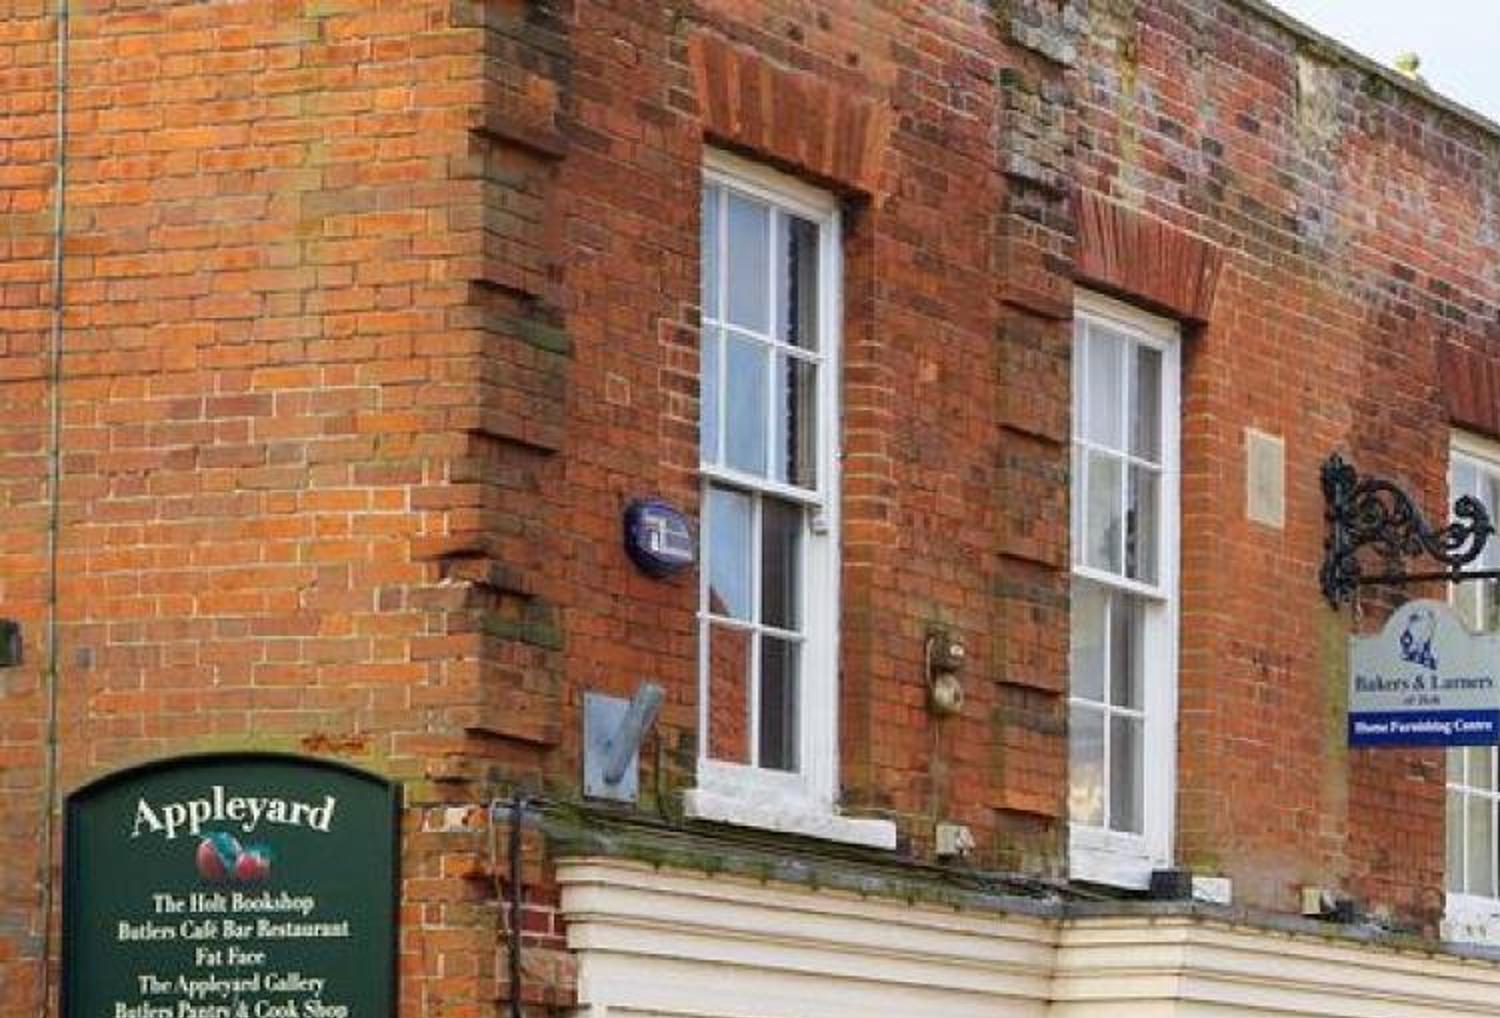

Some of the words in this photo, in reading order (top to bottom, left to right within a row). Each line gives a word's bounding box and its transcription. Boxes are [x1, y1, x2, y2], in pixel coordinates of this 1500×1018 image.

[1412, 674, 1425, 691] &
[1354, 721, 1388, 735] Home
[1390, 719, 1452, 735] Furnishing
[130, 785, 336, 838] Appleyard
[153, 893, 185, 913] The
[190, 892, 227, 913] Holt
[232, 890, 315, 916] Bookshop
[119, 920, 176, 941] Butlers
[180, 919, 218, 941] Café
[223, 919, 254, 939] Bar
[257, 918, 349, 938] Restaurant
[195, 947, 223, 966] Fat
[228, 946, 267, 966] Face
[138, 975, 172, 994] The
[174, 972, 260, 999] Appleyard
[264, 972, 325, 998] Gallery
[235, 1001, 249, 1018] &
